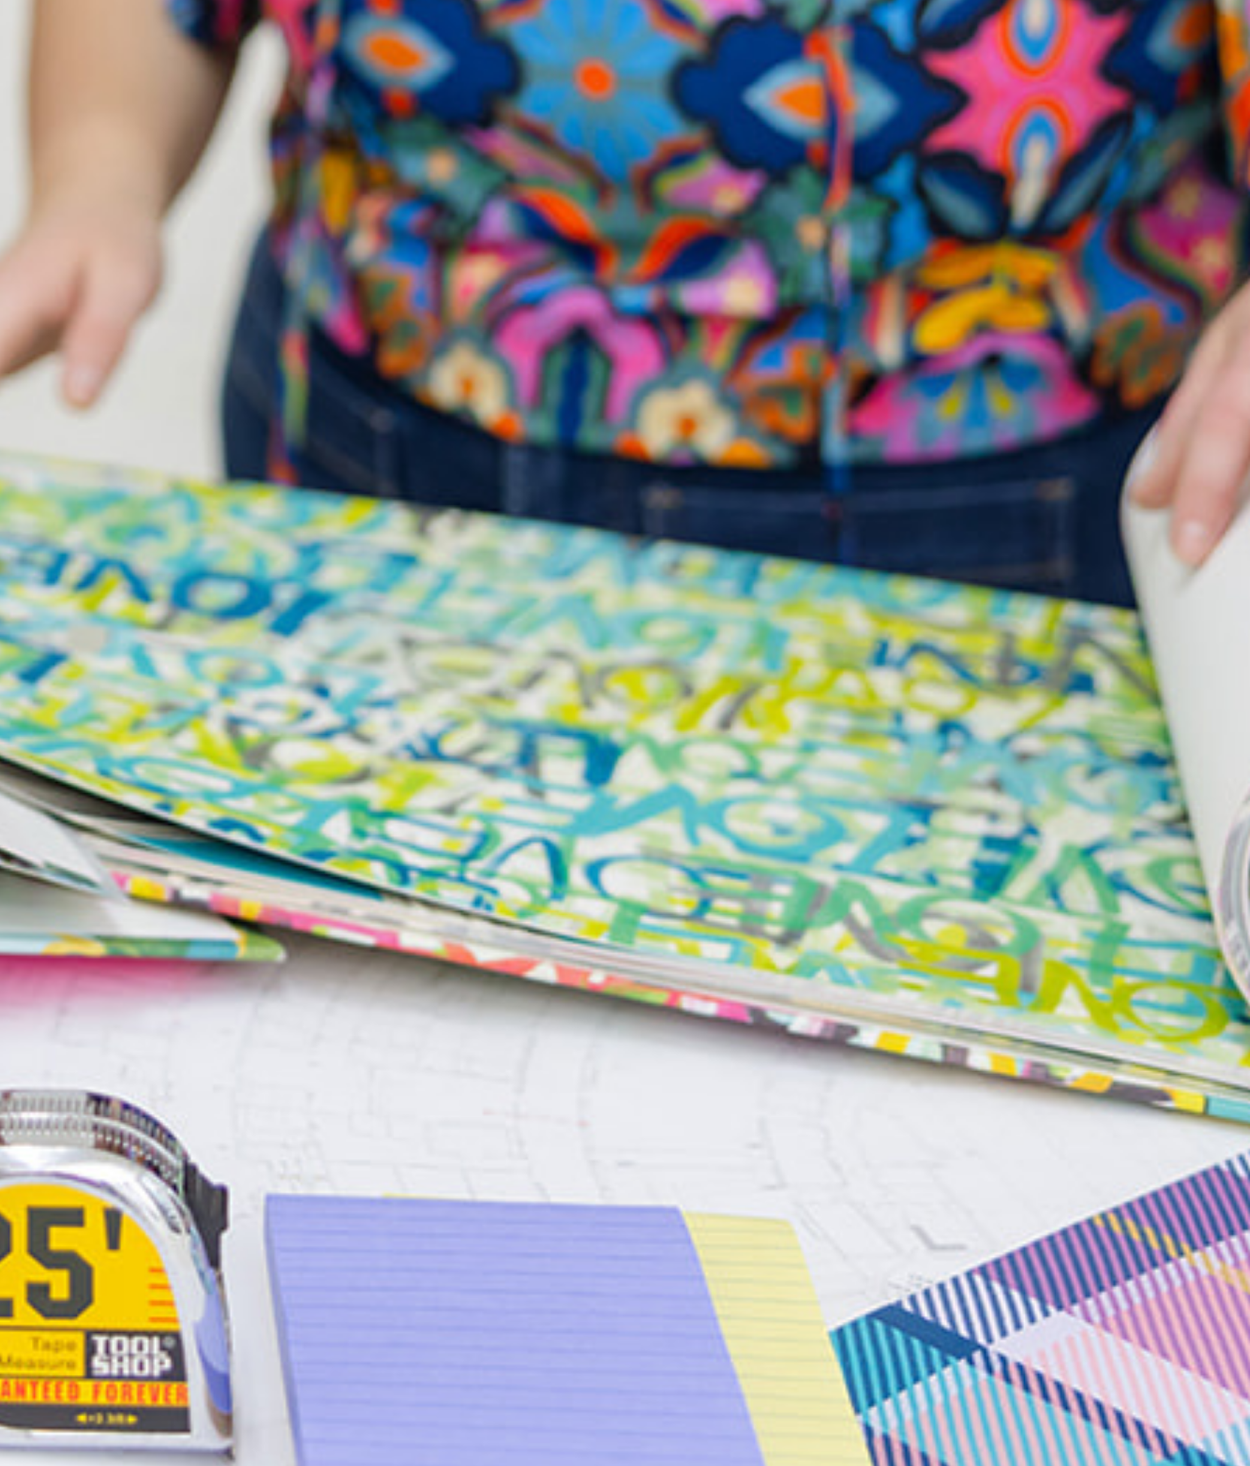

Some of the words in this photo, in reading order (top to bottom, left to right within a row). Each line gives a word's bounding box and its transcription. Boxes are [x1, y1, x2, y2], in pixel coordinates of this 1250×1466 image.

[31, 1337, 78, 1354] Tape
[91, 1335, 161, 1355] TOOL
[91, 1353, 172, 1378] SHOP
[91, 1381, 190, 1406] FOREVER
